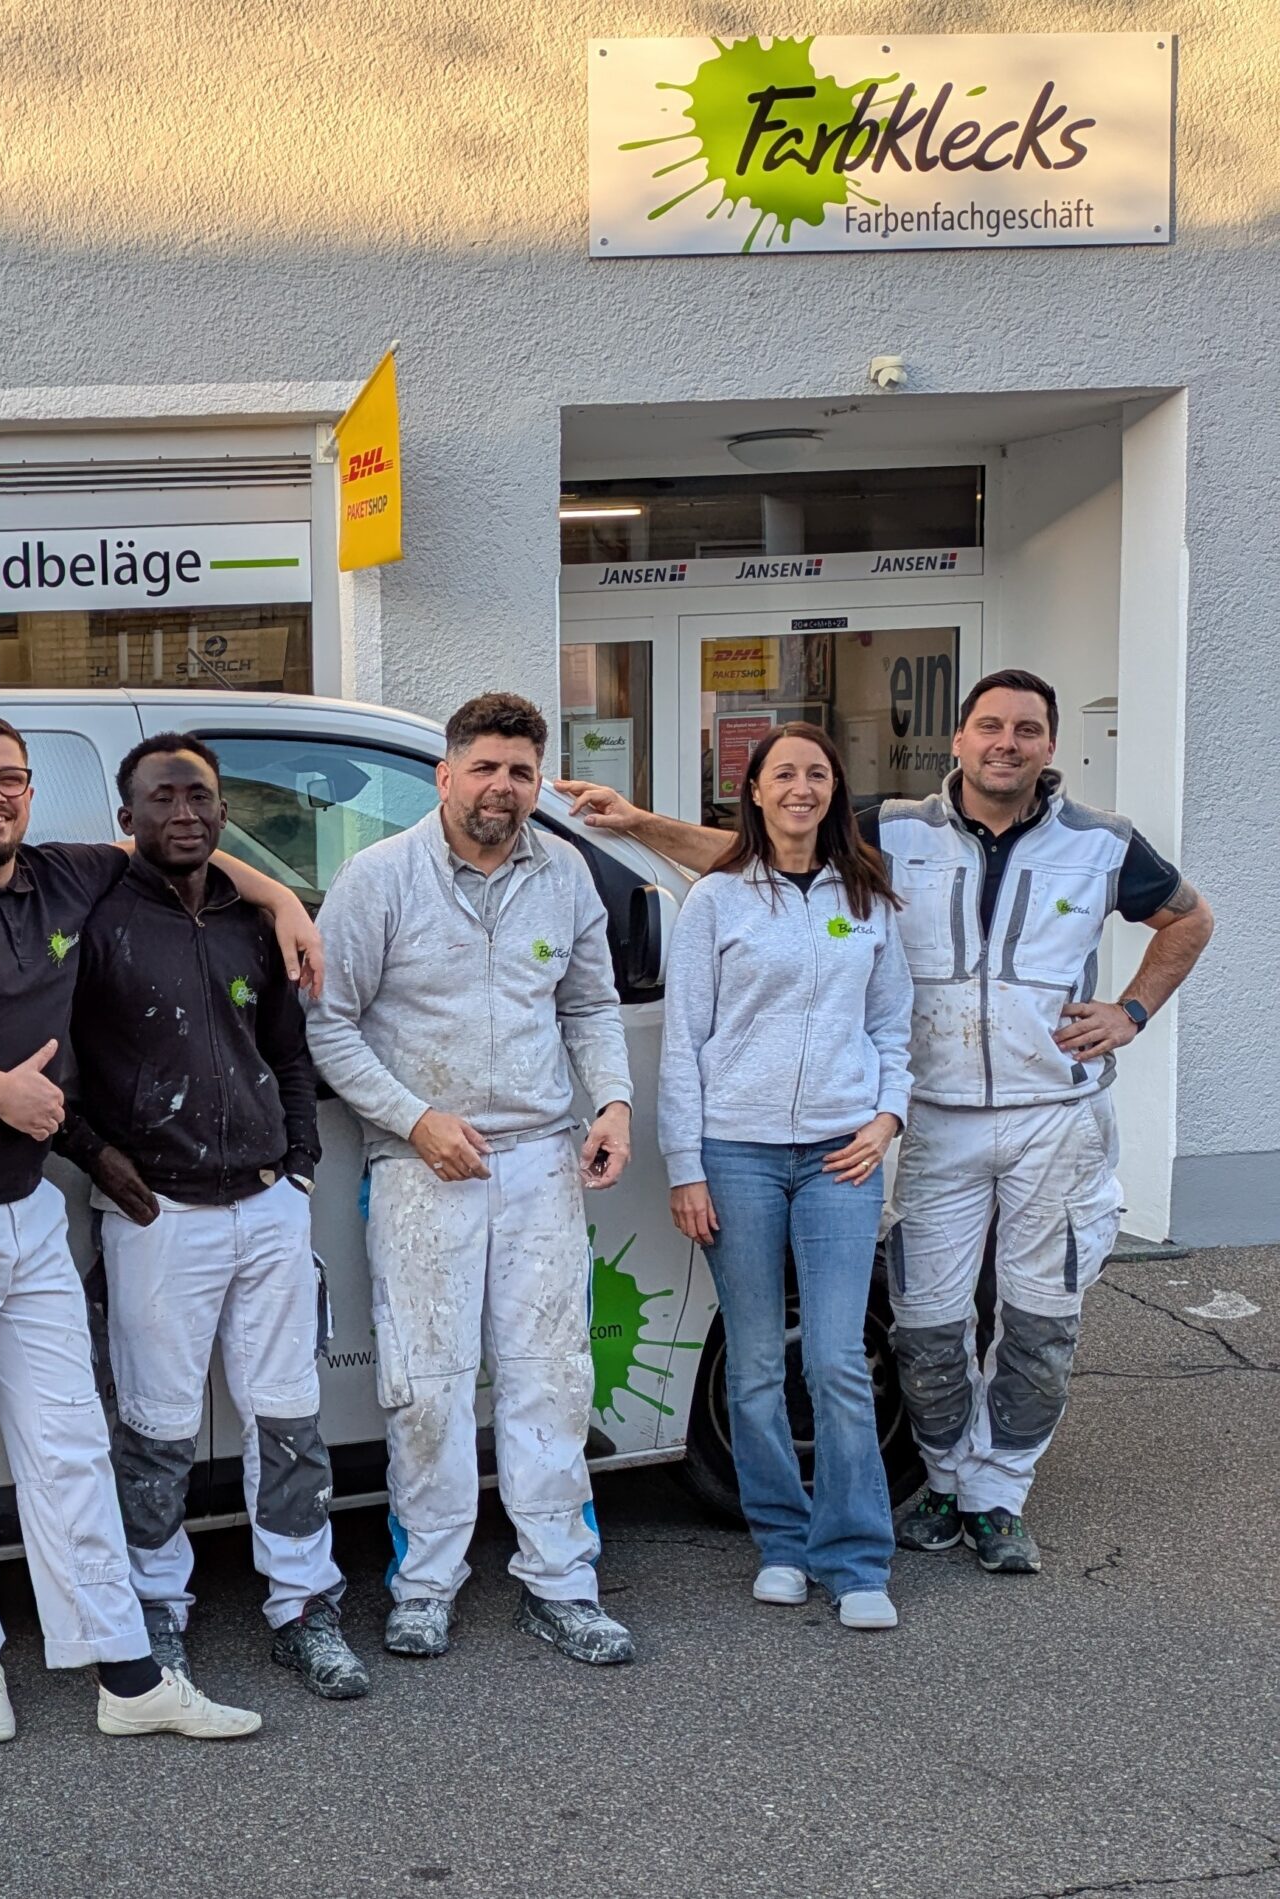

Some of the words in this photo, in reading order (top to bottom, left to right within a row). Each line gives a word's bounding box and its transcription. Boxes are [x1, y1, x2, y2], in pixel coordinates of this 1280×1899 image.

[845, 199, 1095, 237] Farbenfachgeschäft
[346, 446, 387, 482] DHL
[346, 494, 388, 521] PAKETSHOP
[735, 562, 803, 580] JANSEN
[870, 555, 938, 573] JANSEN
[599, 567, 667, 585] JANSEN
[713, 648, 765, 662] DHL
[712, 669, 766, 679] PAKETSHOP
[889, 744, 912, 770] Wir
[837, 923, 876, 936] Bartsch
